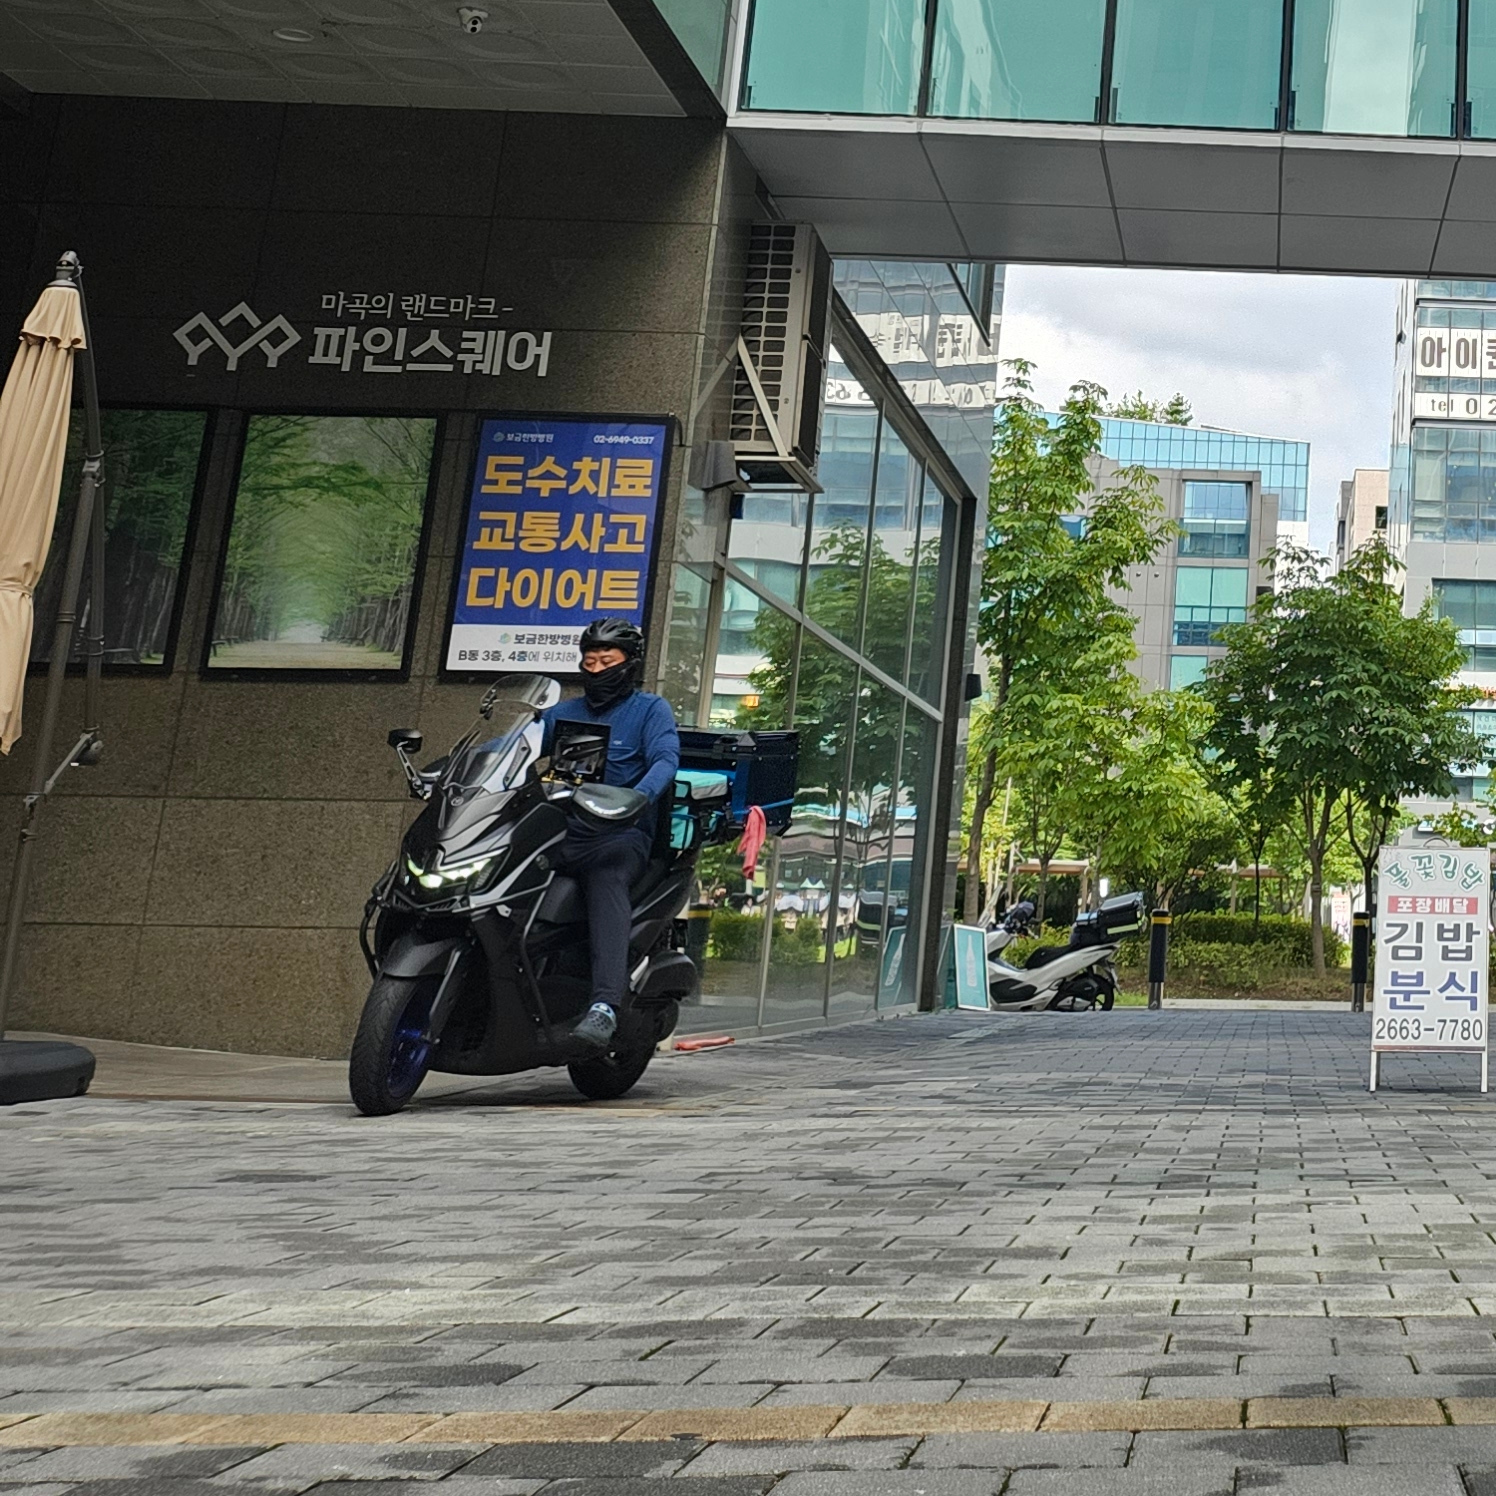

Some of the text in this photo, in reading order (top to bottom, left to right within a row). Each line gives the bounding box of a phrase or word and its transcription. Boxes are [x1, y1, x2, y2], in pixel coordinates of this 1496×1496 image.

[320, 291, 394, 320] 마곡의
[308, 326, 553, 377] 파인스퀘어
[506, 432, 554, 443] 보금한방병원
[593, 435, 655, 445] 02-6949-0337
[480, 455, 654, 498] 도수치료
[472, 511, 647, 554] 교통사고
[465, 567, 640, 610] 다이어트
[458, 650, 479, 662] B동
[1384, 854, 1484, 890] 풀꽃김밥
[1397, 898, 1469, 914] 포장배달
[1384, 922, 1481, 961] 김밥
[1383, 971, 1479, 1012] 분식
[1375, 1018, 1483, 1041] 2663-7780
